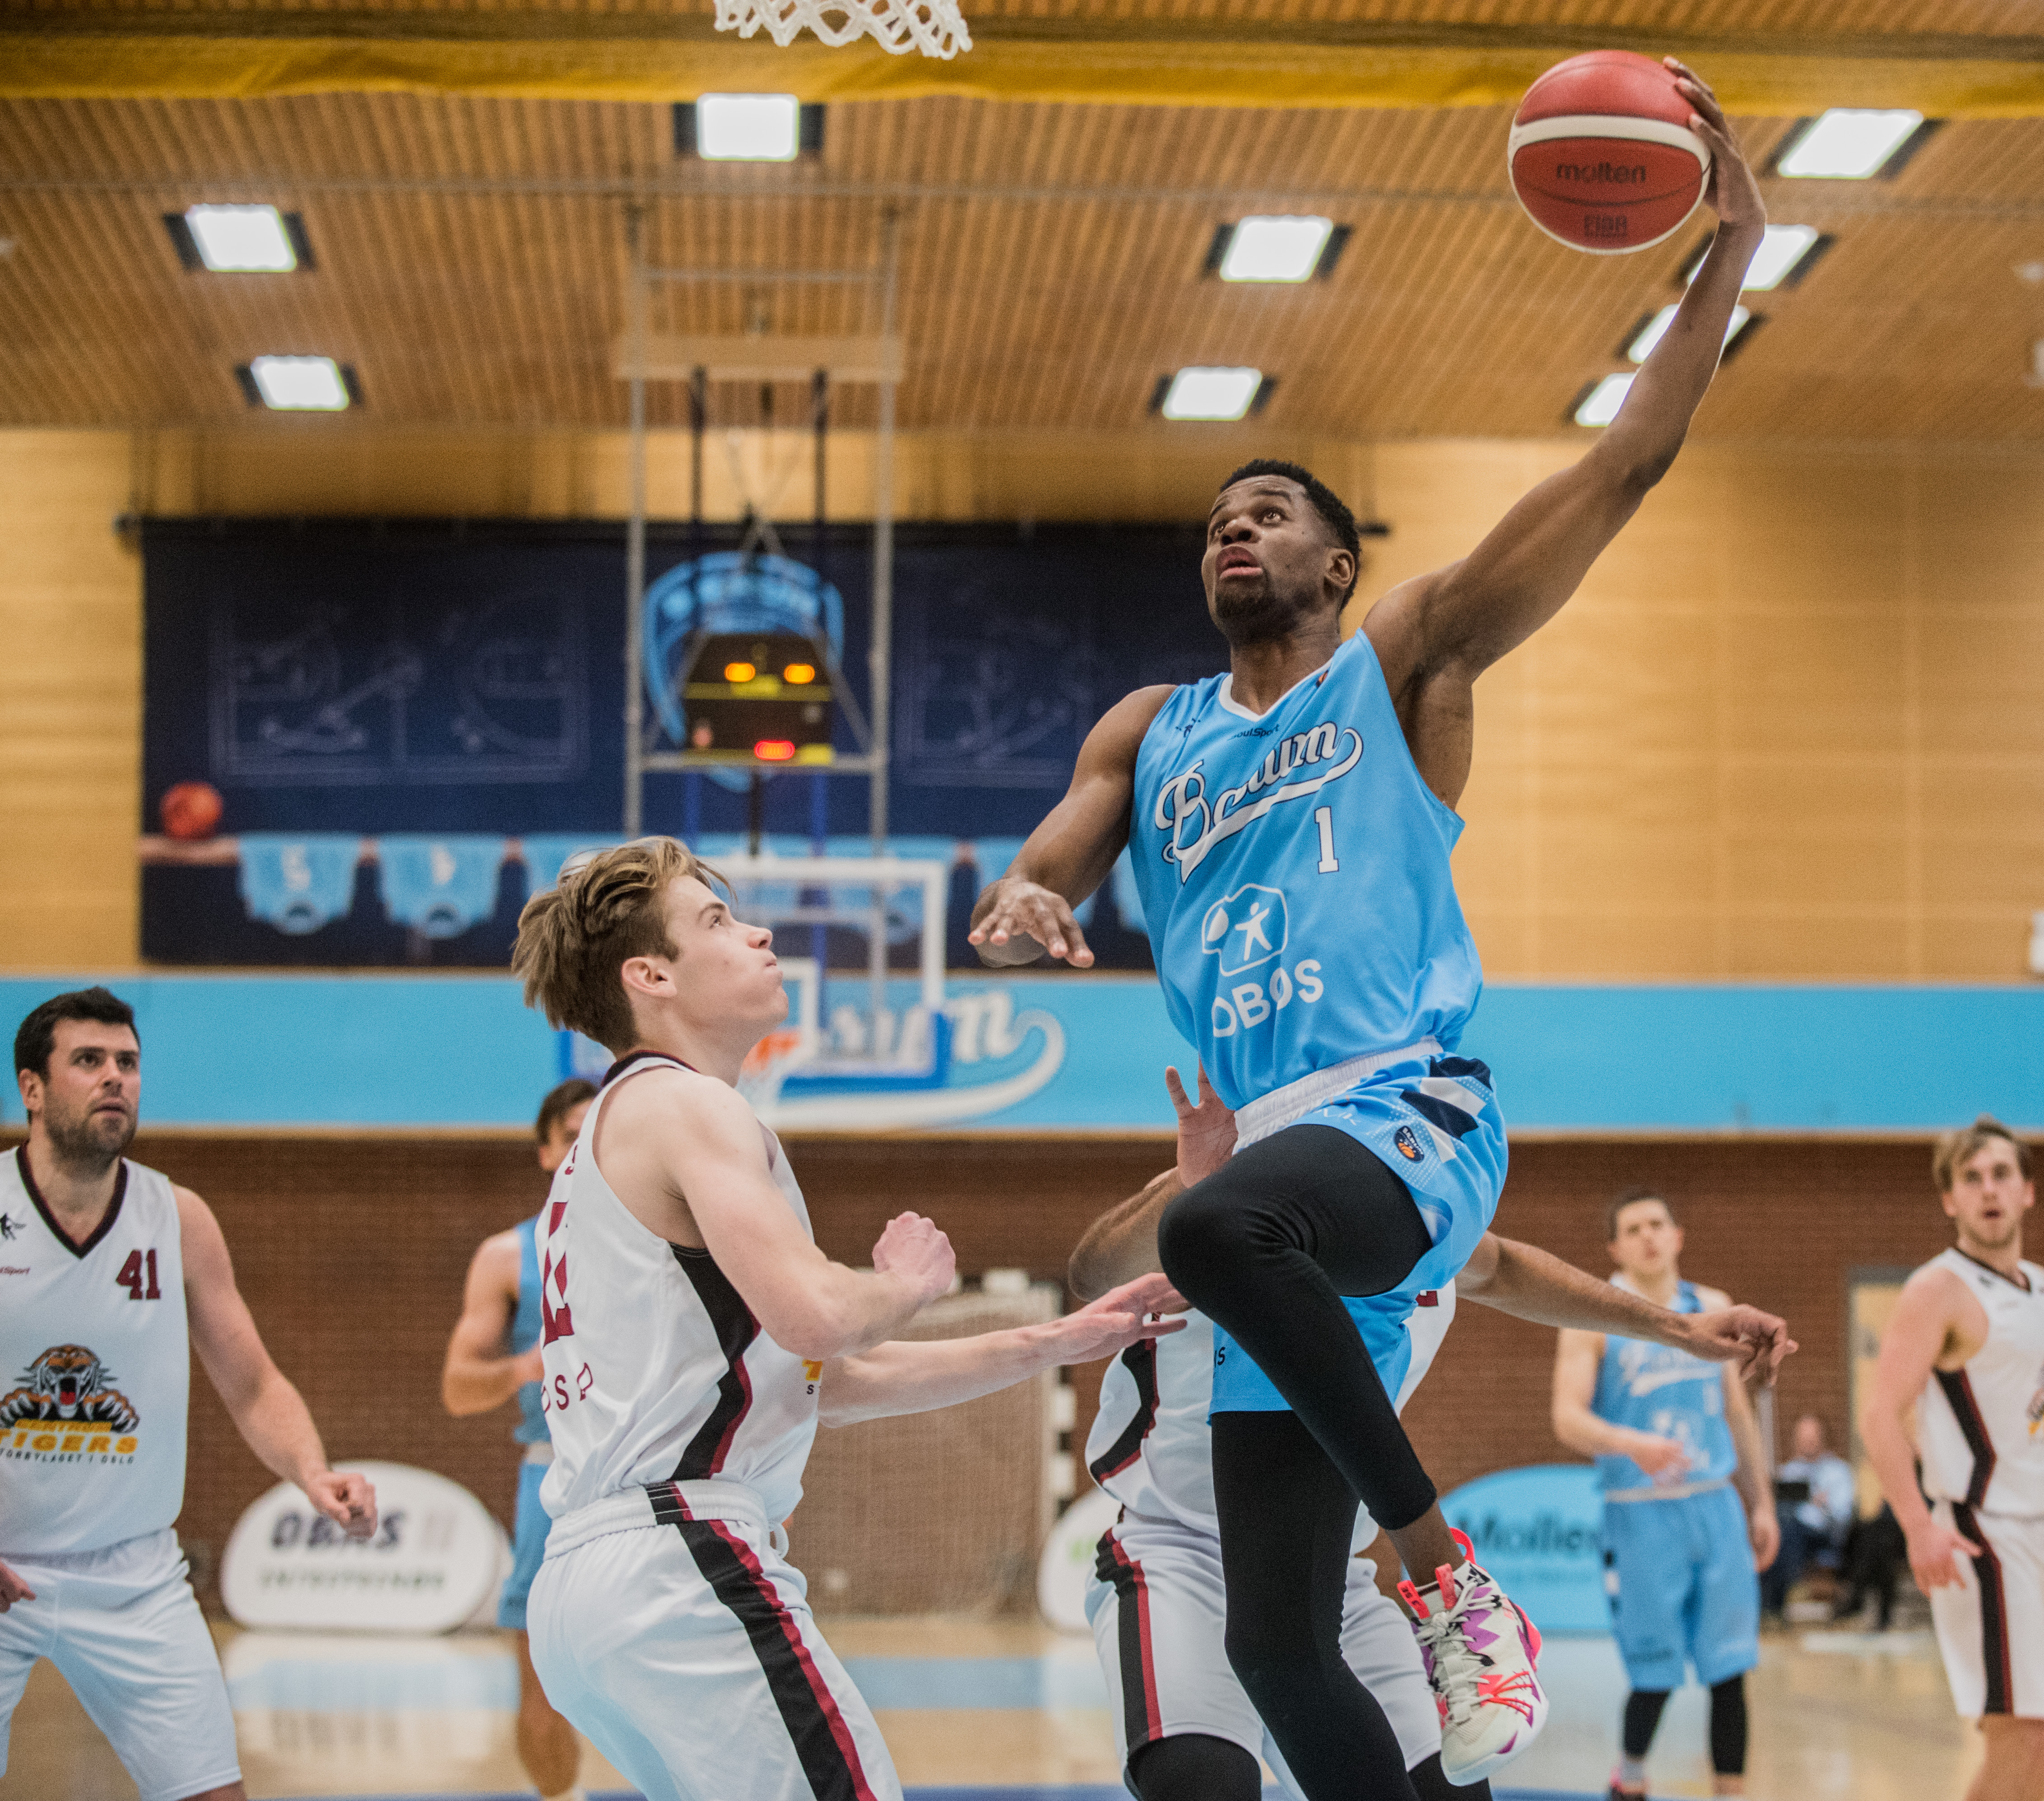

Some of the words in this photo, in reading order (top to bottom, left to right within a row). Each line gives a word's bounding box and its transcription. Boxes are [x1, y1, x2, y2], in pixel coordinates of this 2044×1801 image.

[1556, 161, 1647, 185] molten
[1314, 805, 1340, 875] 1
[116, 1248, 161, 1300] 41
